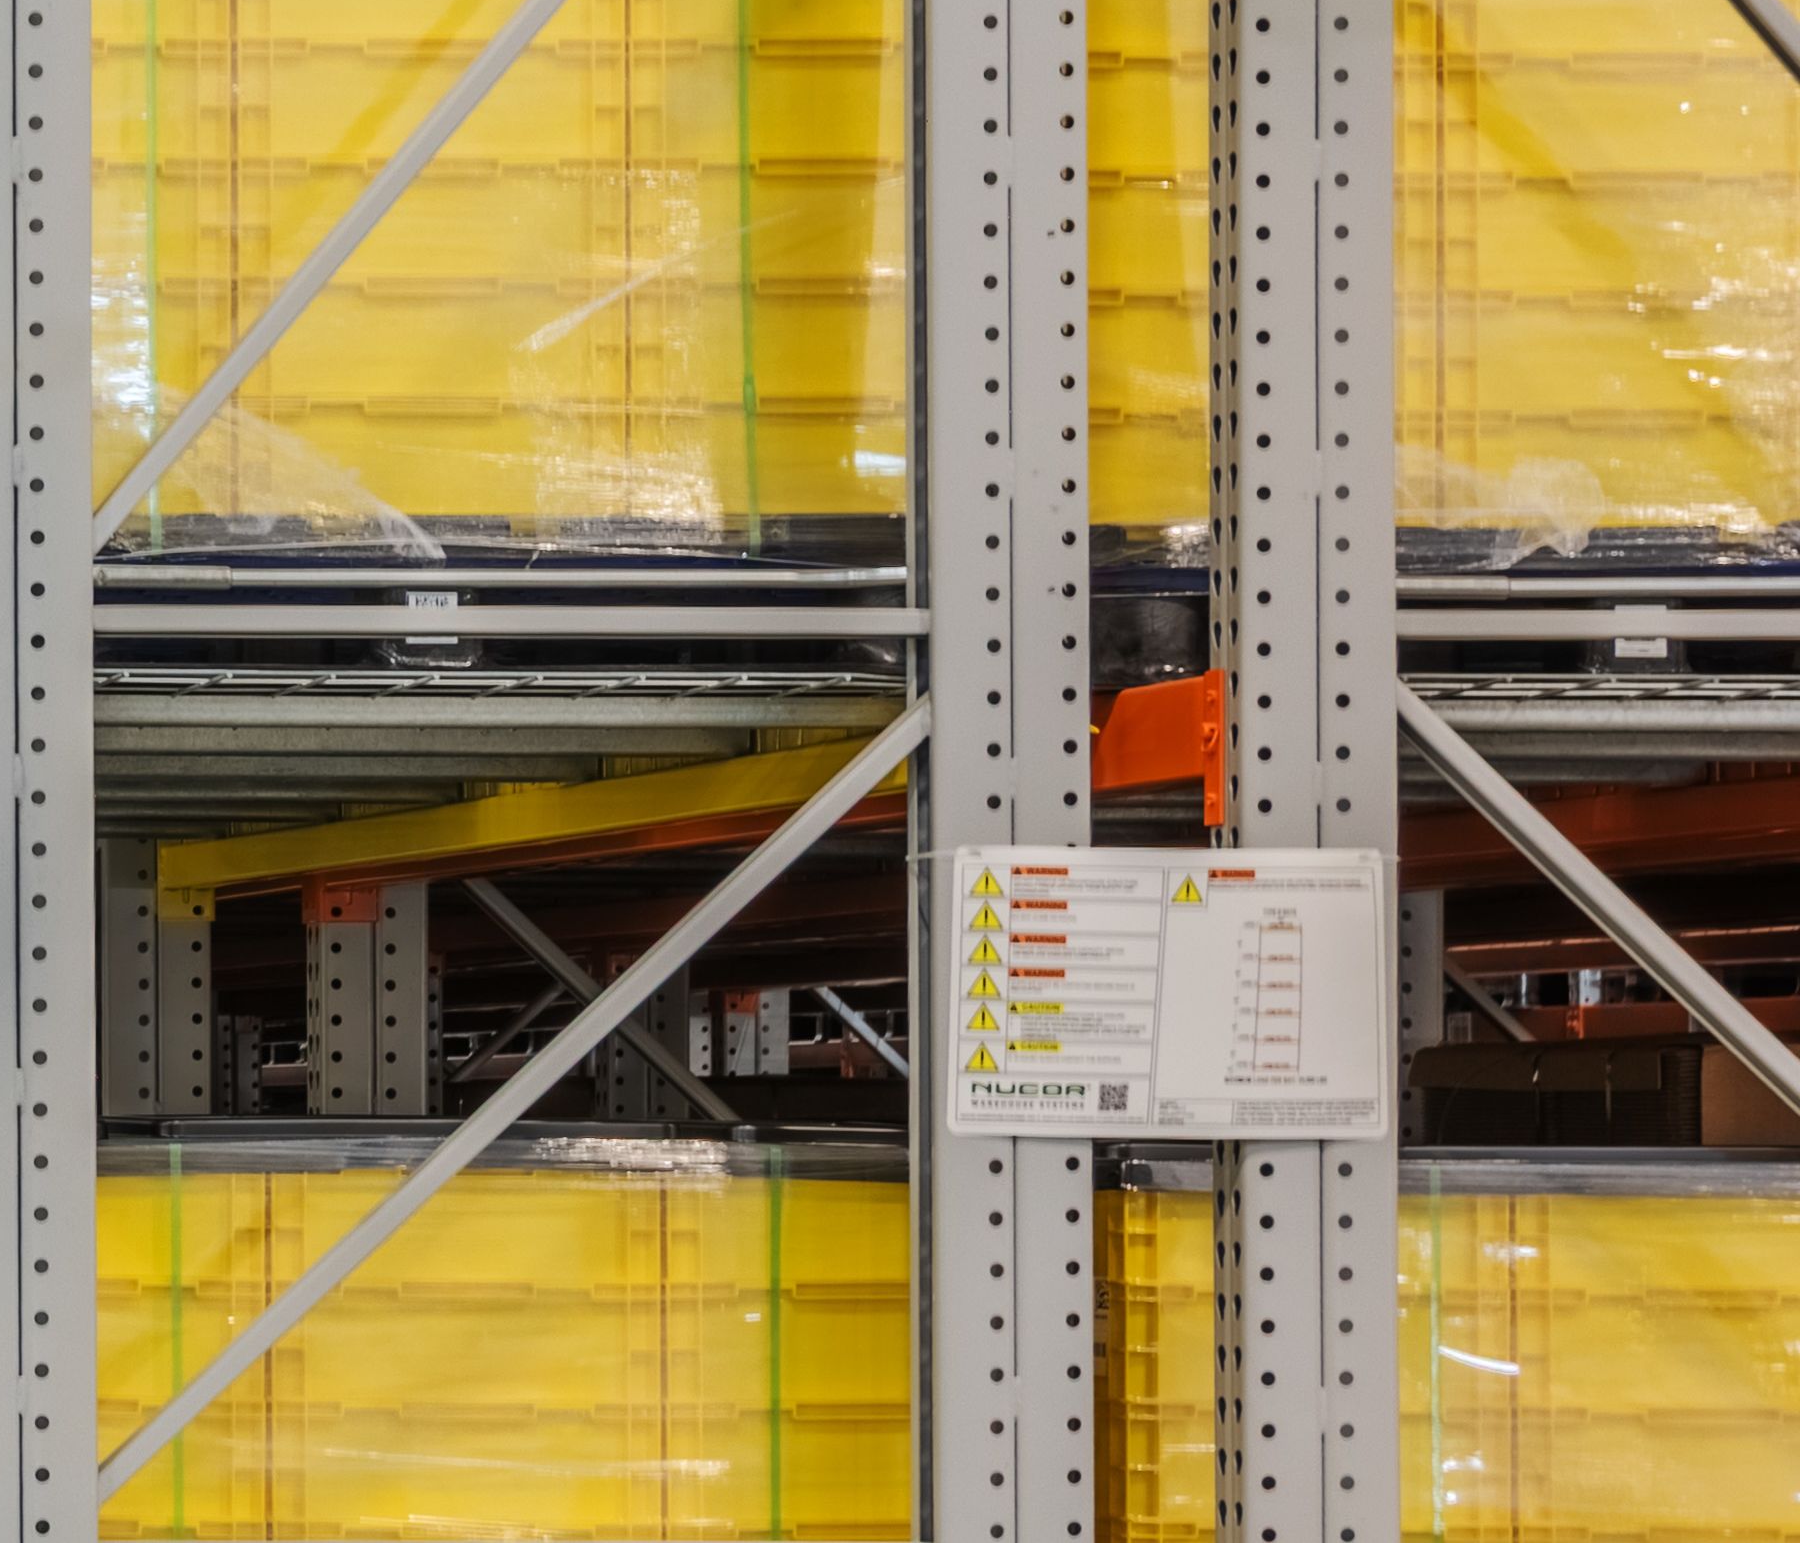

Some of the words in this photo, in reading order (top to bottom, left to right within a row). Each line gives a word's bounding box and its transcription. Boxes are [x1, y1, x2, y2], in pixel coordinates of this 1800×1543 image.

[971, 1084, 1086, 1096] NUCOR
[971, 1100, 1034, 1109] WAREHOUSE
[1039, 1100, 1085, 1109] SYSTEMS
